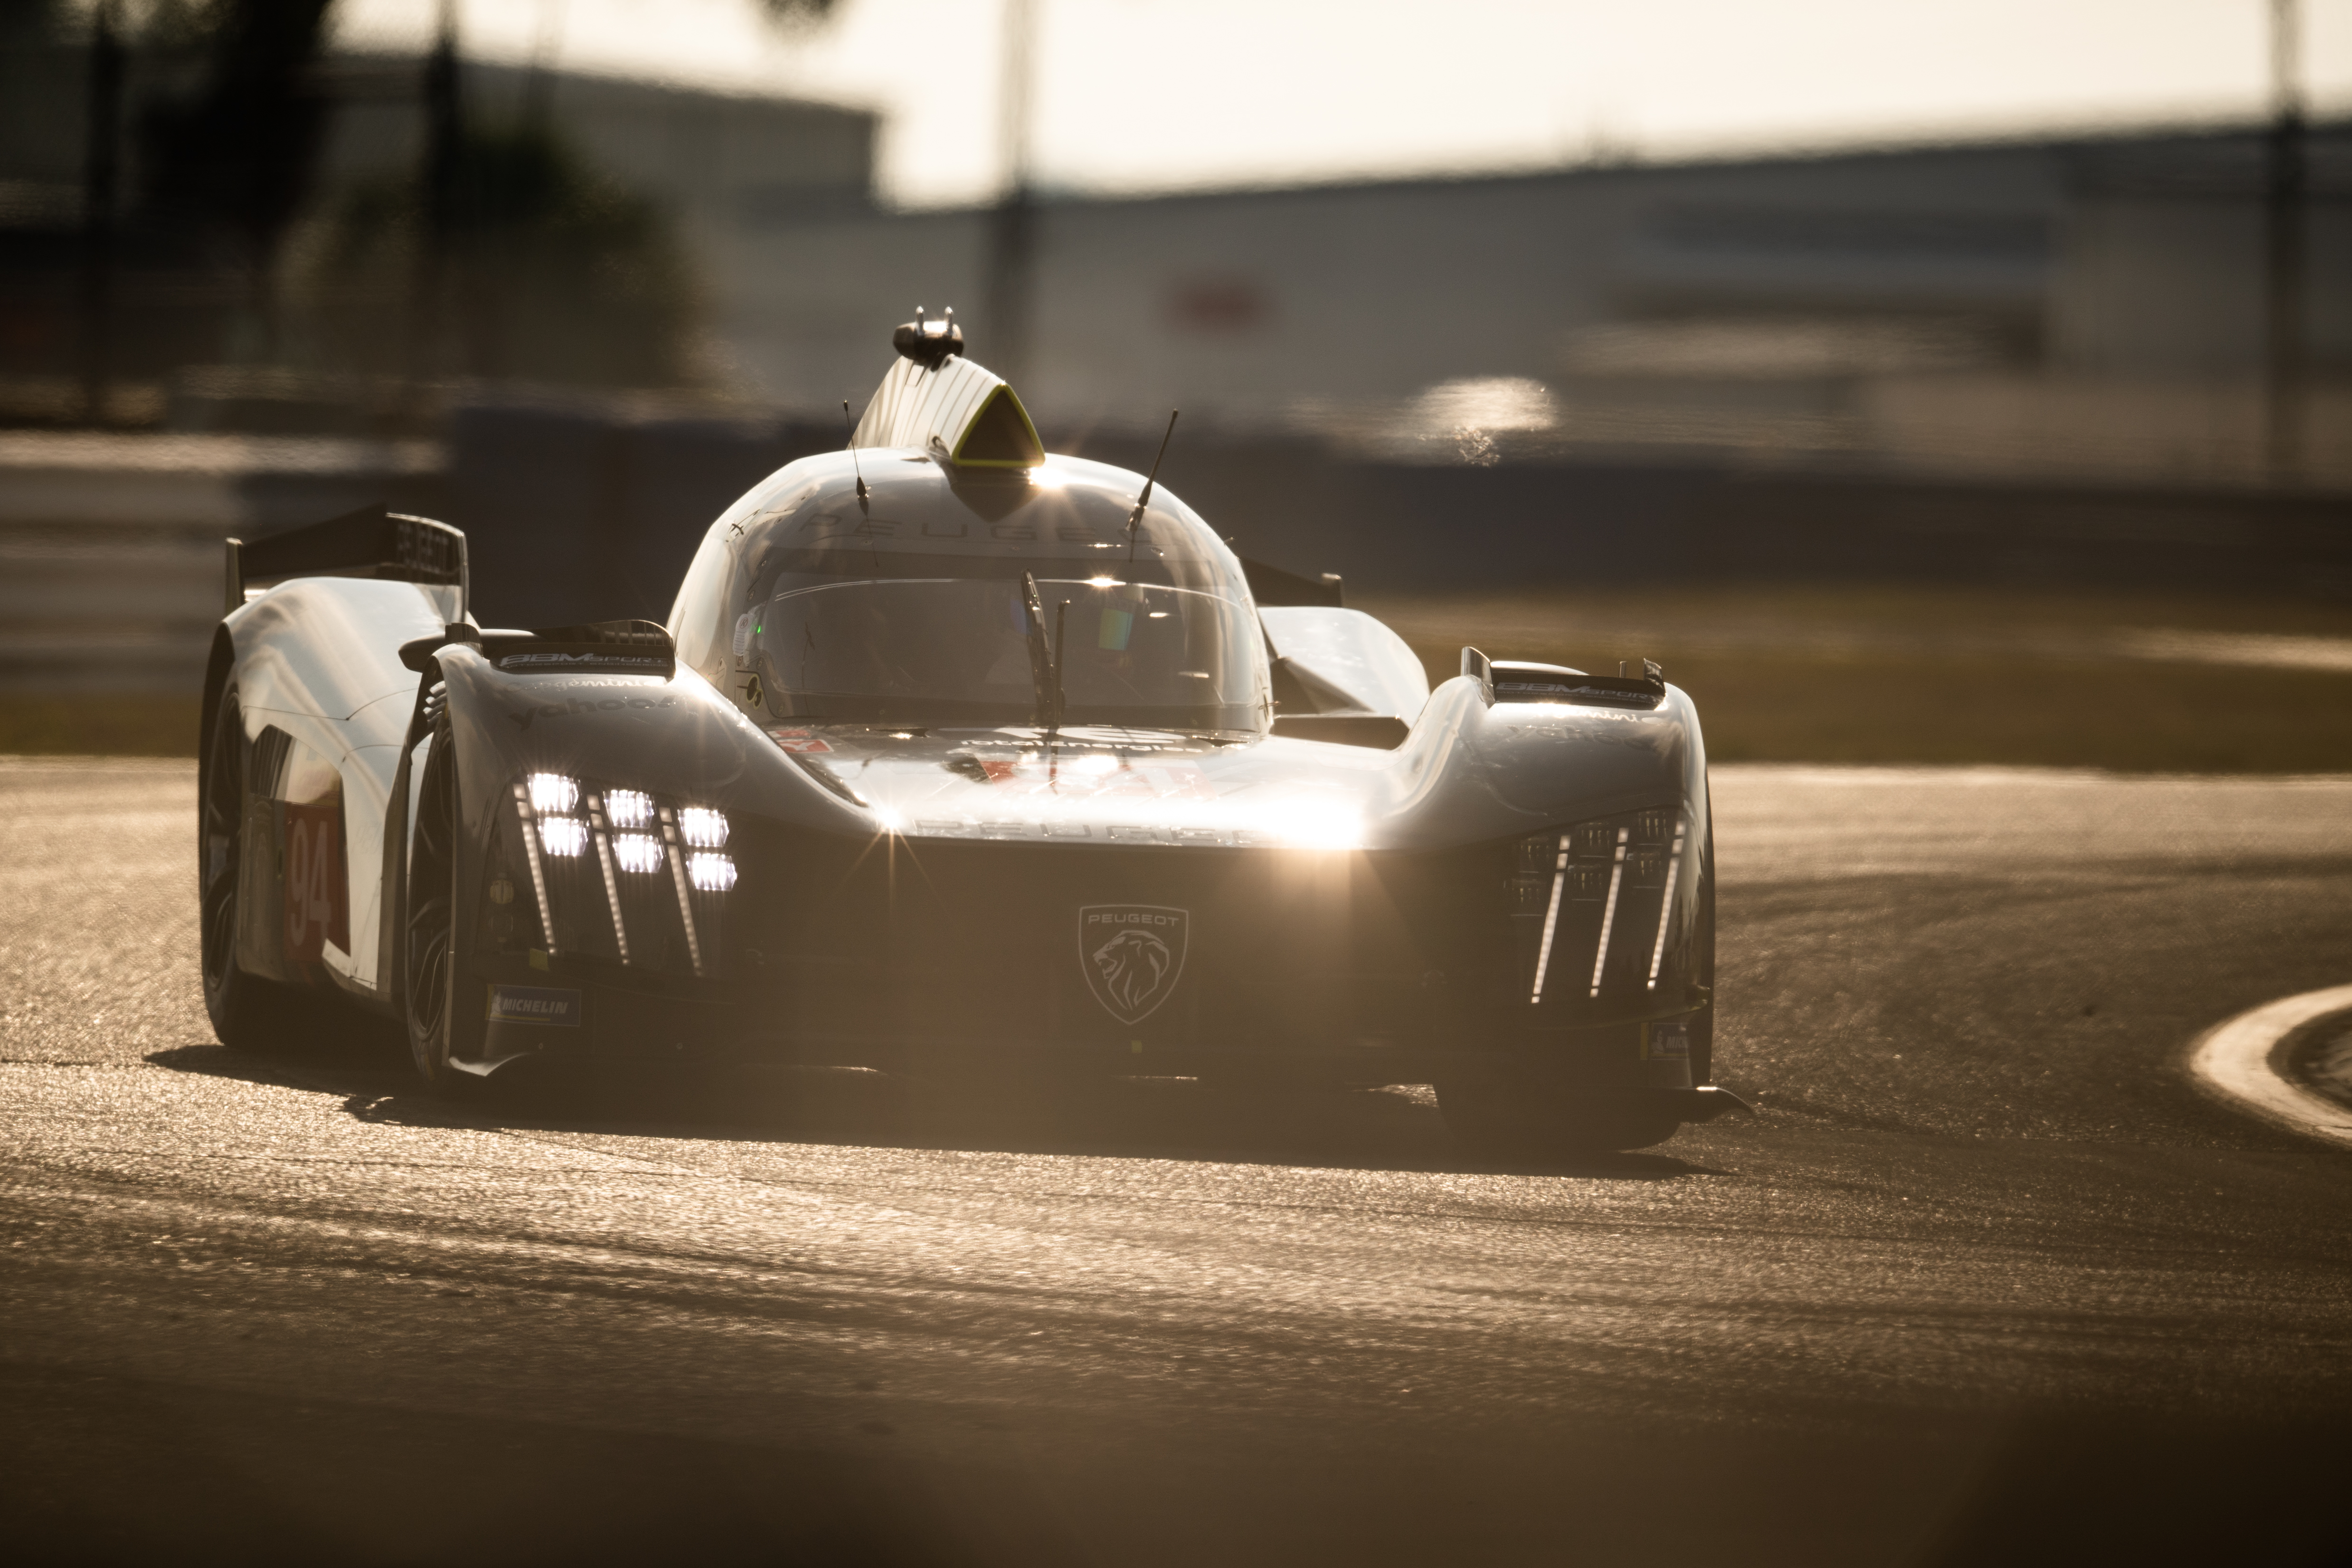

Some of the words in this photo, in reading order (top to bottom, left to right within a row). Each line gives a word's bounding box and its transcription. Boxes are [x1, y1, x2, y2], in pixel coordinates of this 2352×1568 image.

[798, 512, 1182, 544] PEUGEO
[1496, 682, 1656, 700] BBMSPOR
[508, 696, 675, 732] yahoo!
[291, 818, 331, 947] 94
[1088, 914, 1179, 926] PEUGEOT
[502, 998, 568, 1014] MICHELIN
